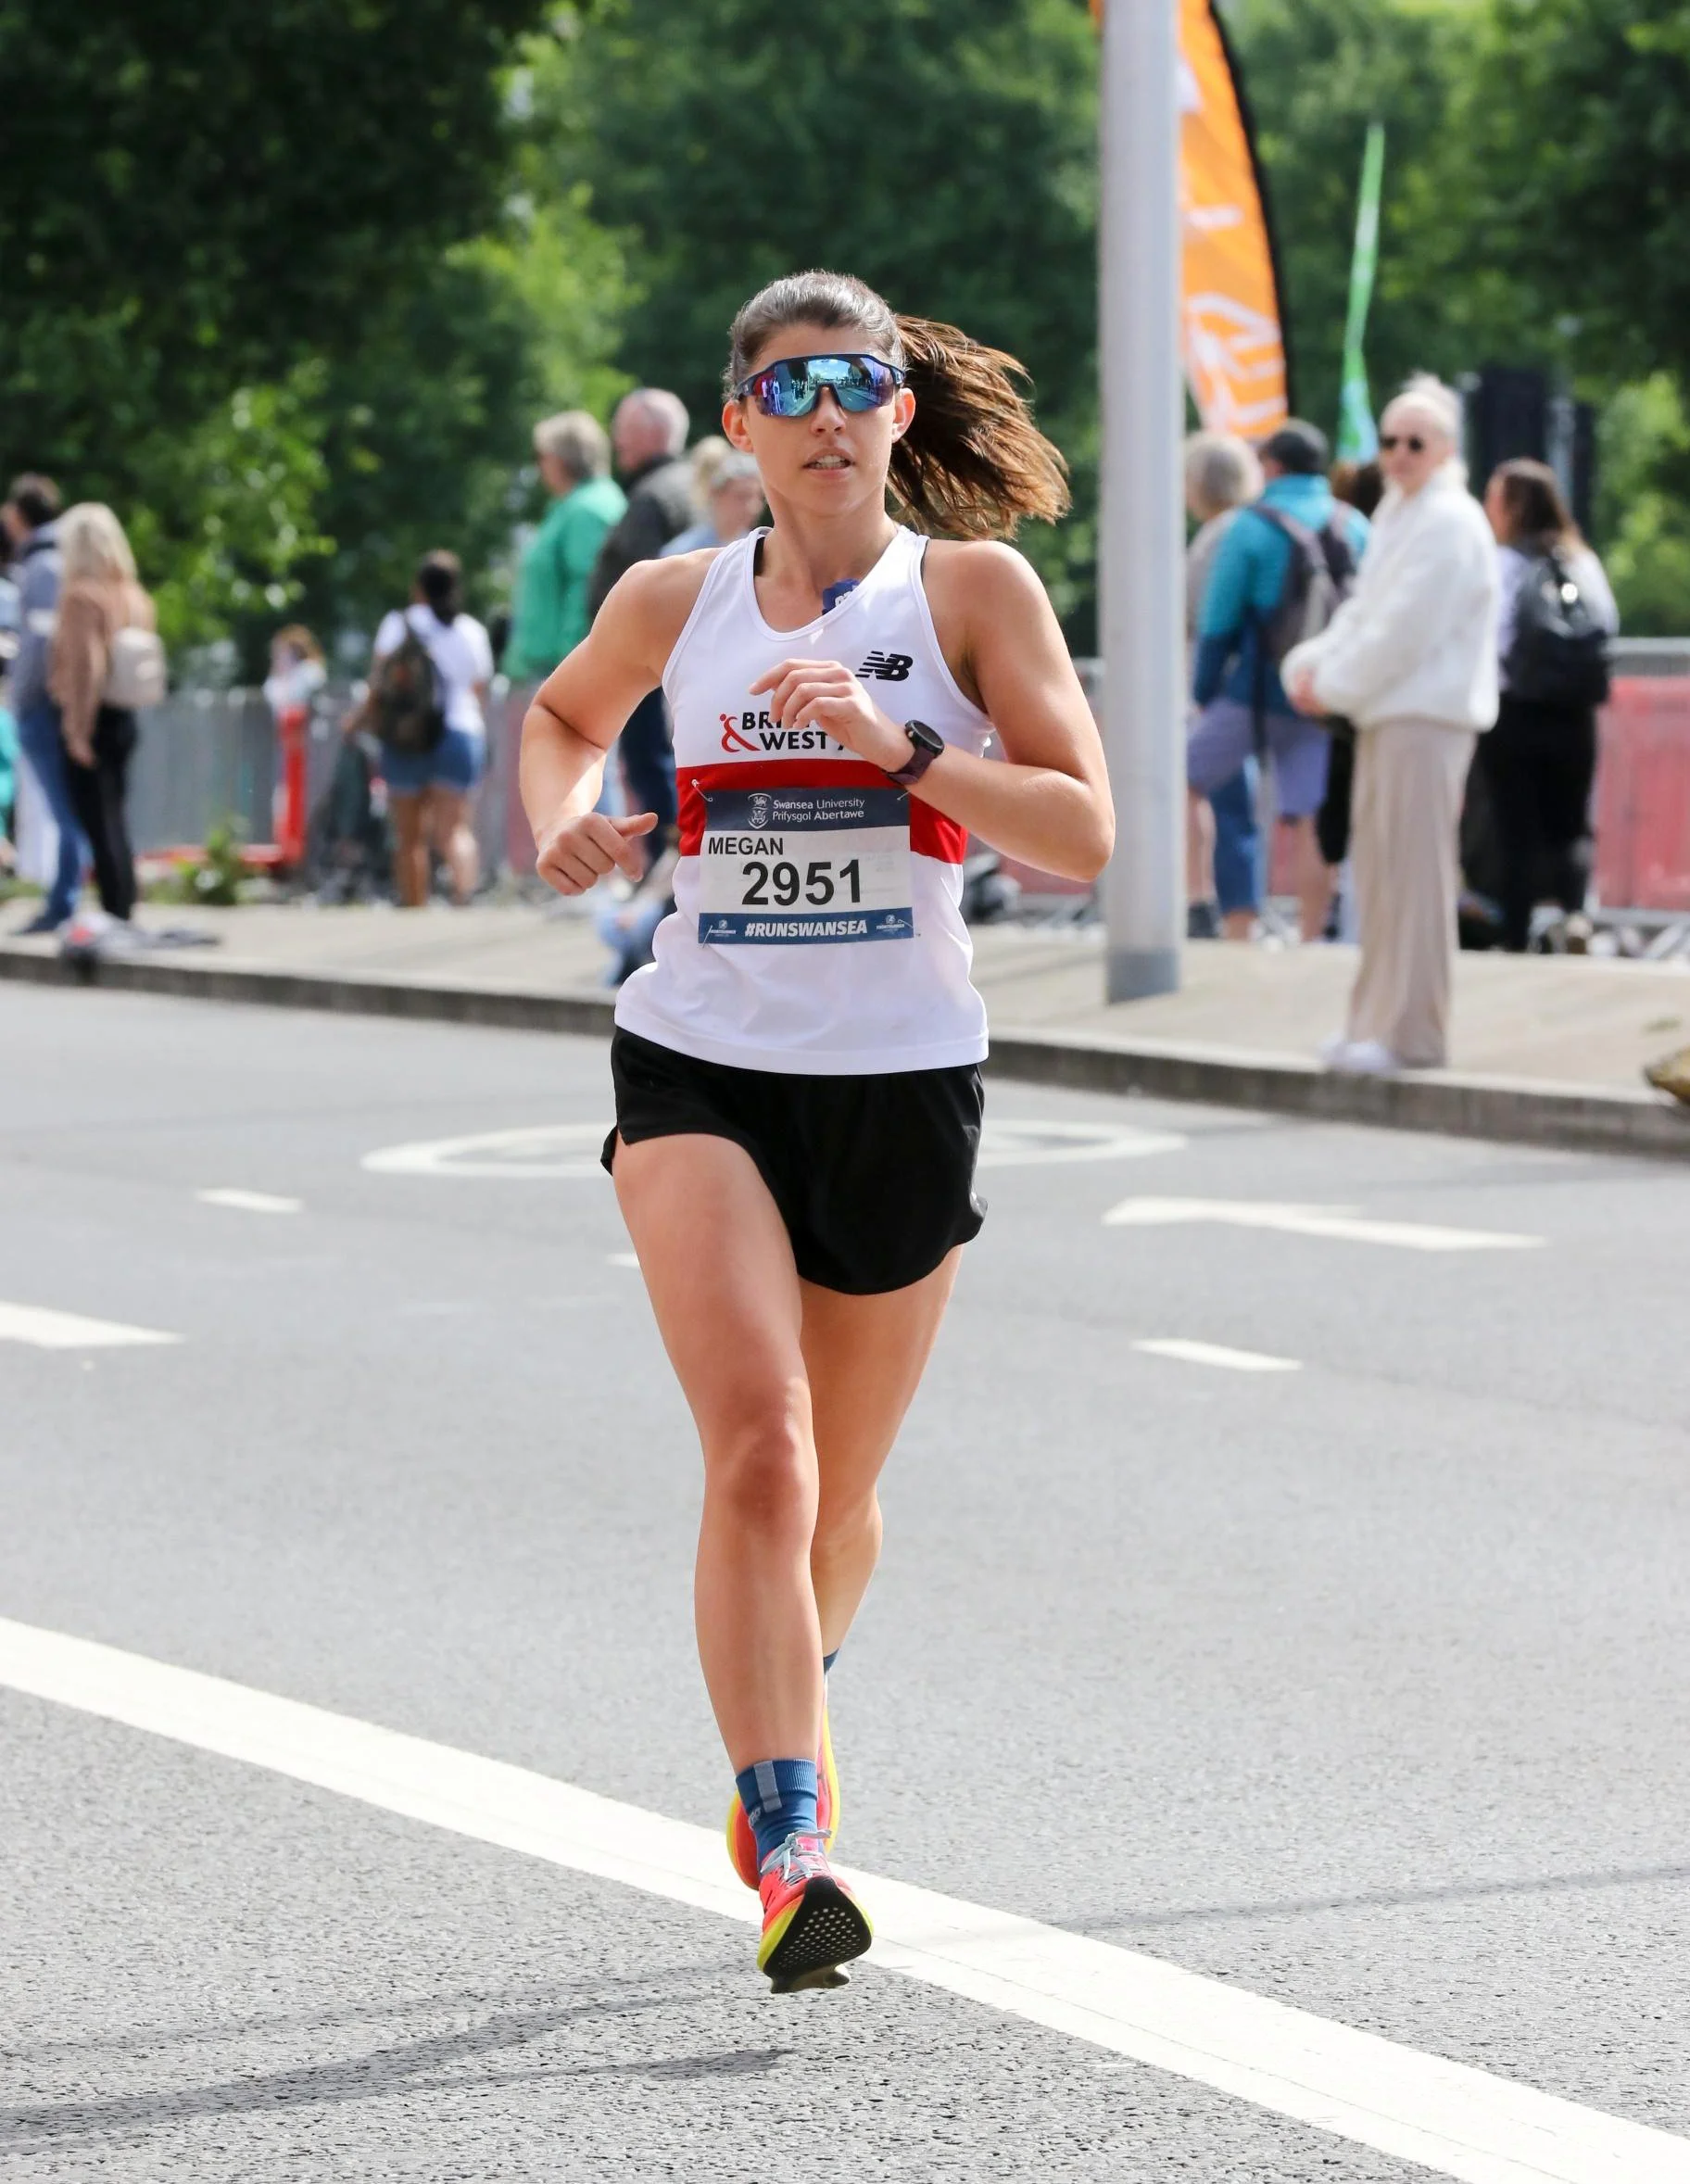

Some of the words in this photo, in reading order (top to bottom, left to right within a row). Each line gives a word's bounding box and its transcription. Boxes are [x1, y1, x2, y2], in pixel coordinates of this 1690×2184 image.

[759, 731, 828, 751] WEST
[773, 800, 813, 810] Swansea
[816, 797, 865, 809] University
[772, 810, 812, 823] Prifysgol
[813, 809, 864, 820] Abertawe
[708, 837, 784, 855] MEGAN
[741, 859, 861, 906] 2951
[744, 919, 868, 938] #RUNSWANSEA
